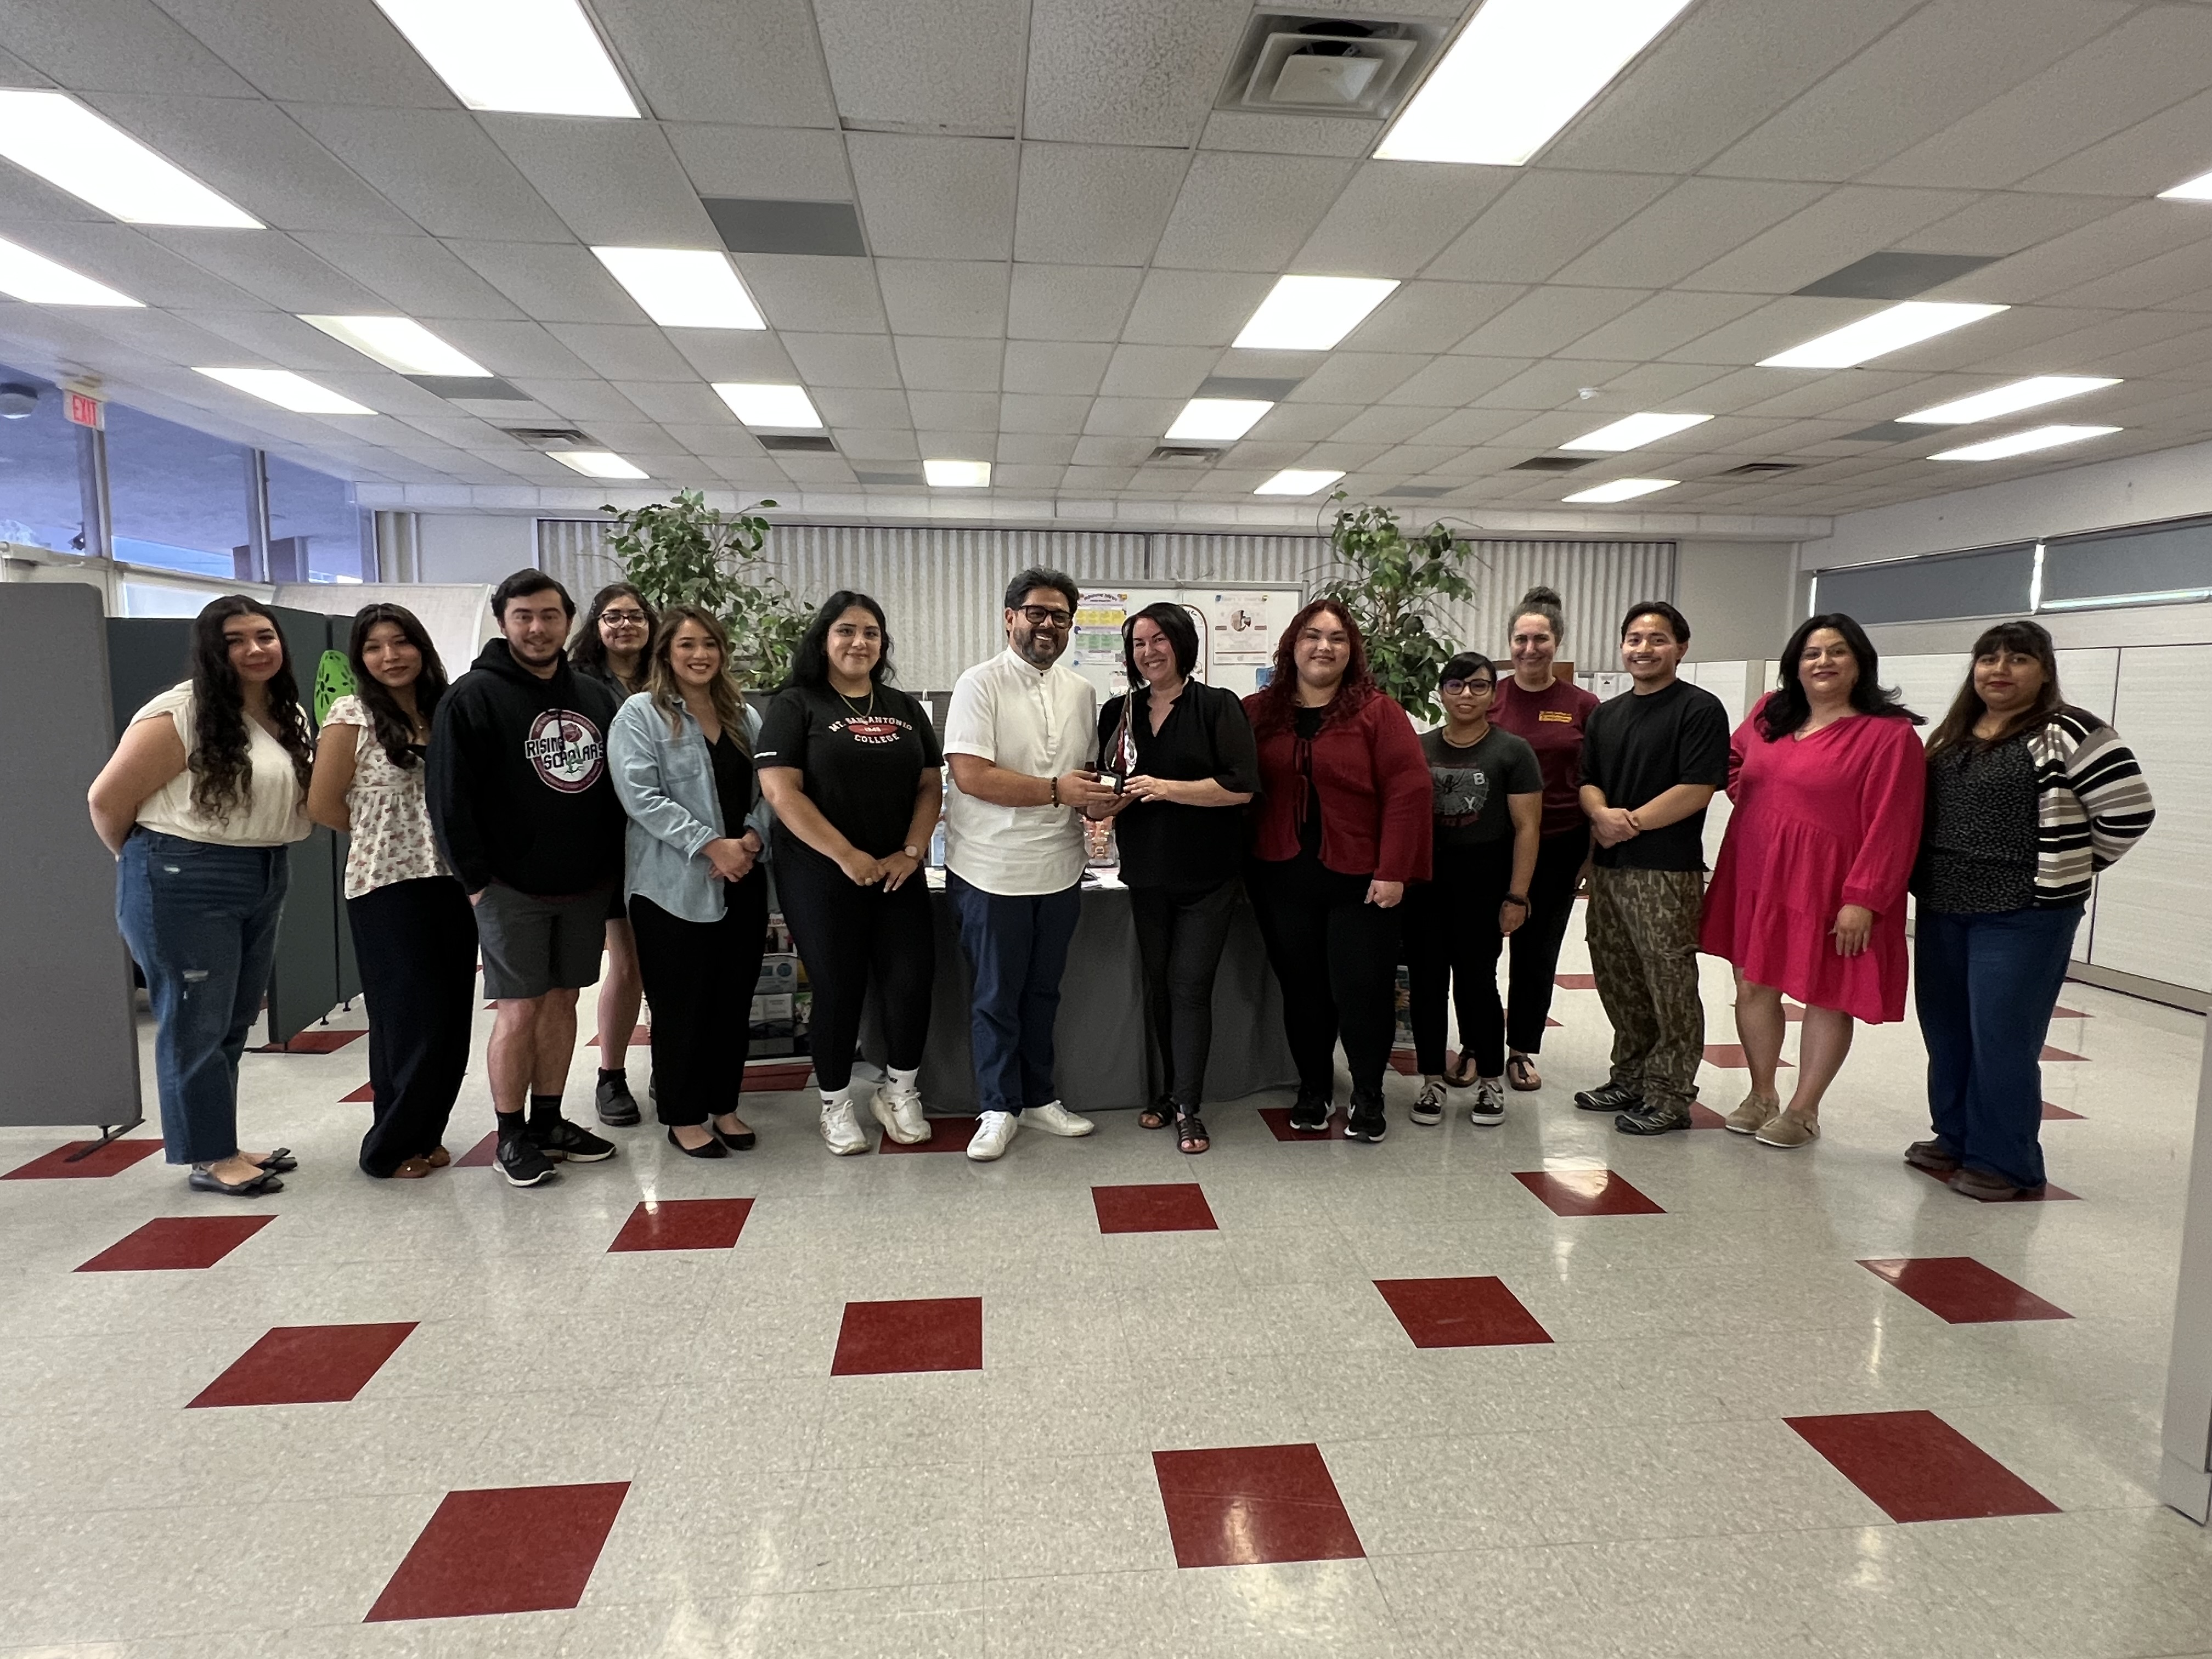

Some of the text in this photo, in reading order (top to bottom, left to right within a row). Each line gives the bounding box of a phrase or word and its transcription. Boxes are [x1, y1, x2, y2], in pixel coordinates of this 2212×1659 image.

[72, 394, 97, 426] EXIT
[868, 716, 913, 731] ANTONIO
[854, 733, 900, 744] COLLEGE
[1473, 772, 1486, 786] B
[1463, 797, 1476, 810] Y
